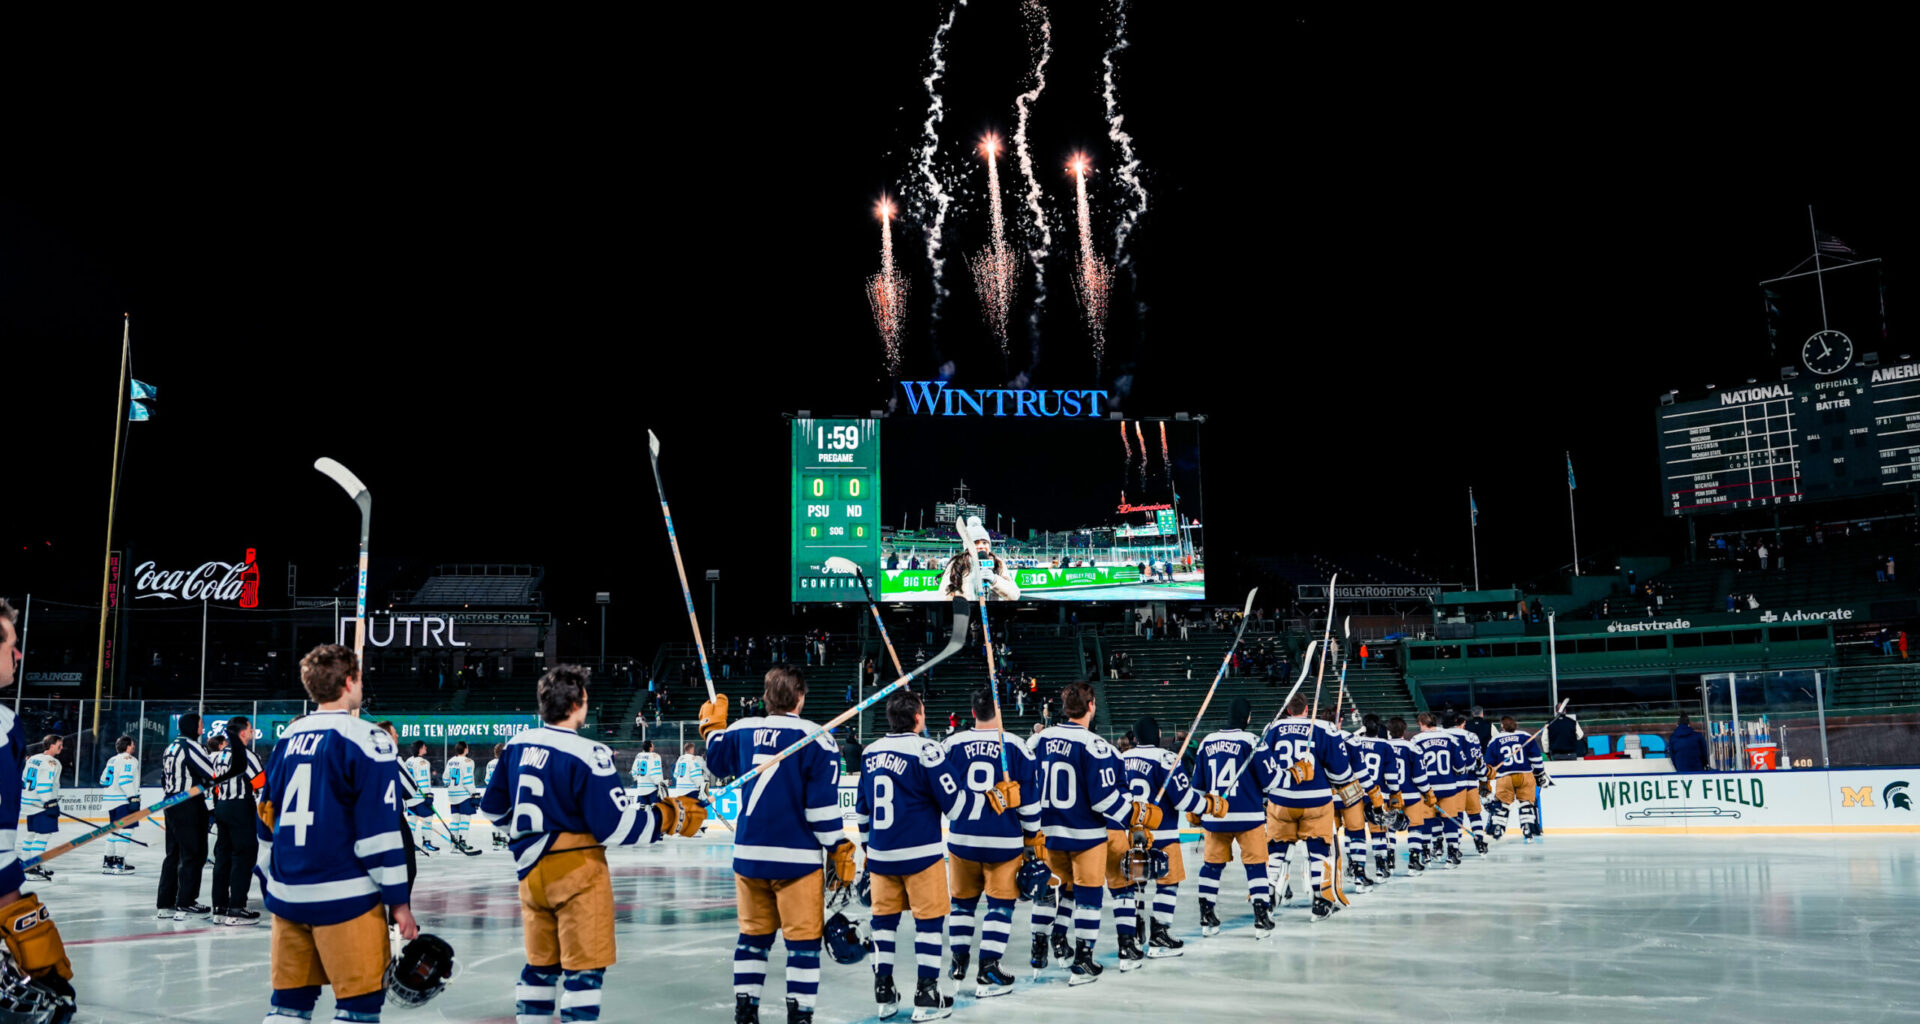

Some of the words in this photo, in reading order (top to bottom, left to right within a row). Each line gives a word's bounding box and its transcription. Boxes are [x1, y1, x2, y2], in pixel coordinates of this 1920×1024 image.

[1720, 383, 1793, 405] NATIONAL
[1815, 378, 1858, 390] OFFICIALS
[900, 381, 1109, 416] WINTRUST
[1816, 399, 1851, 411] BATTER
[817, 426, 859, 450] 1:59
[1849, 427, 1868, 435] STRIKE
[818, 454, 854, 463] PREGAME
[813, 478, 824, 497] 0
[849, 478, 860, 497] 0
[808, 505, 829, 517] PSU
[847, 505, 862, 517] ND
[810, 526, 817, 537] 0
[829, 527, 844, 535] SOG
[857, 526, 863, 537] 0
[134, 560, 255, 600] Coca-Cola
[904, 577, 919, 587] BIG
[1782, 607, 1851, 622] Advocate
[25, 671, 82, 682] GRAINGER
[402, 724, 420, 737] BIG
[424, 724, 443, 737] TEN
[447, 724, 489, 737] HOCKEY
[964, 741, 1001, 760] PETERS
[1500, 744, 1523, 767] 30
[1753, 753, 1764, 764] G
[830, 760, 838, 785] 7
[1424, 749, 1450, 775] 20
[1794, 759, 1813, 767] 400
[746, 753, 780, 816] 7
[939, 773, 957, 794] 8
[1041, 761, 1077, 809] 10
[1099, 767, 1116, 788] 10
[1172, 772, 1189, 791] 13
[1208, 757, 1239, 797] 14
[279, 763, 314, 846] 4
[383, 779, 396, 811] 4
[609, 787, 627, 812] 6
[873, 775, 894, 830] 8
[1598, 779, 1693, 811] WRIGLEY
[1702, 778, 1764, 808] FIELD
[1841, 786, 1874, 807] M
[510, 773, 544, 839] 6
